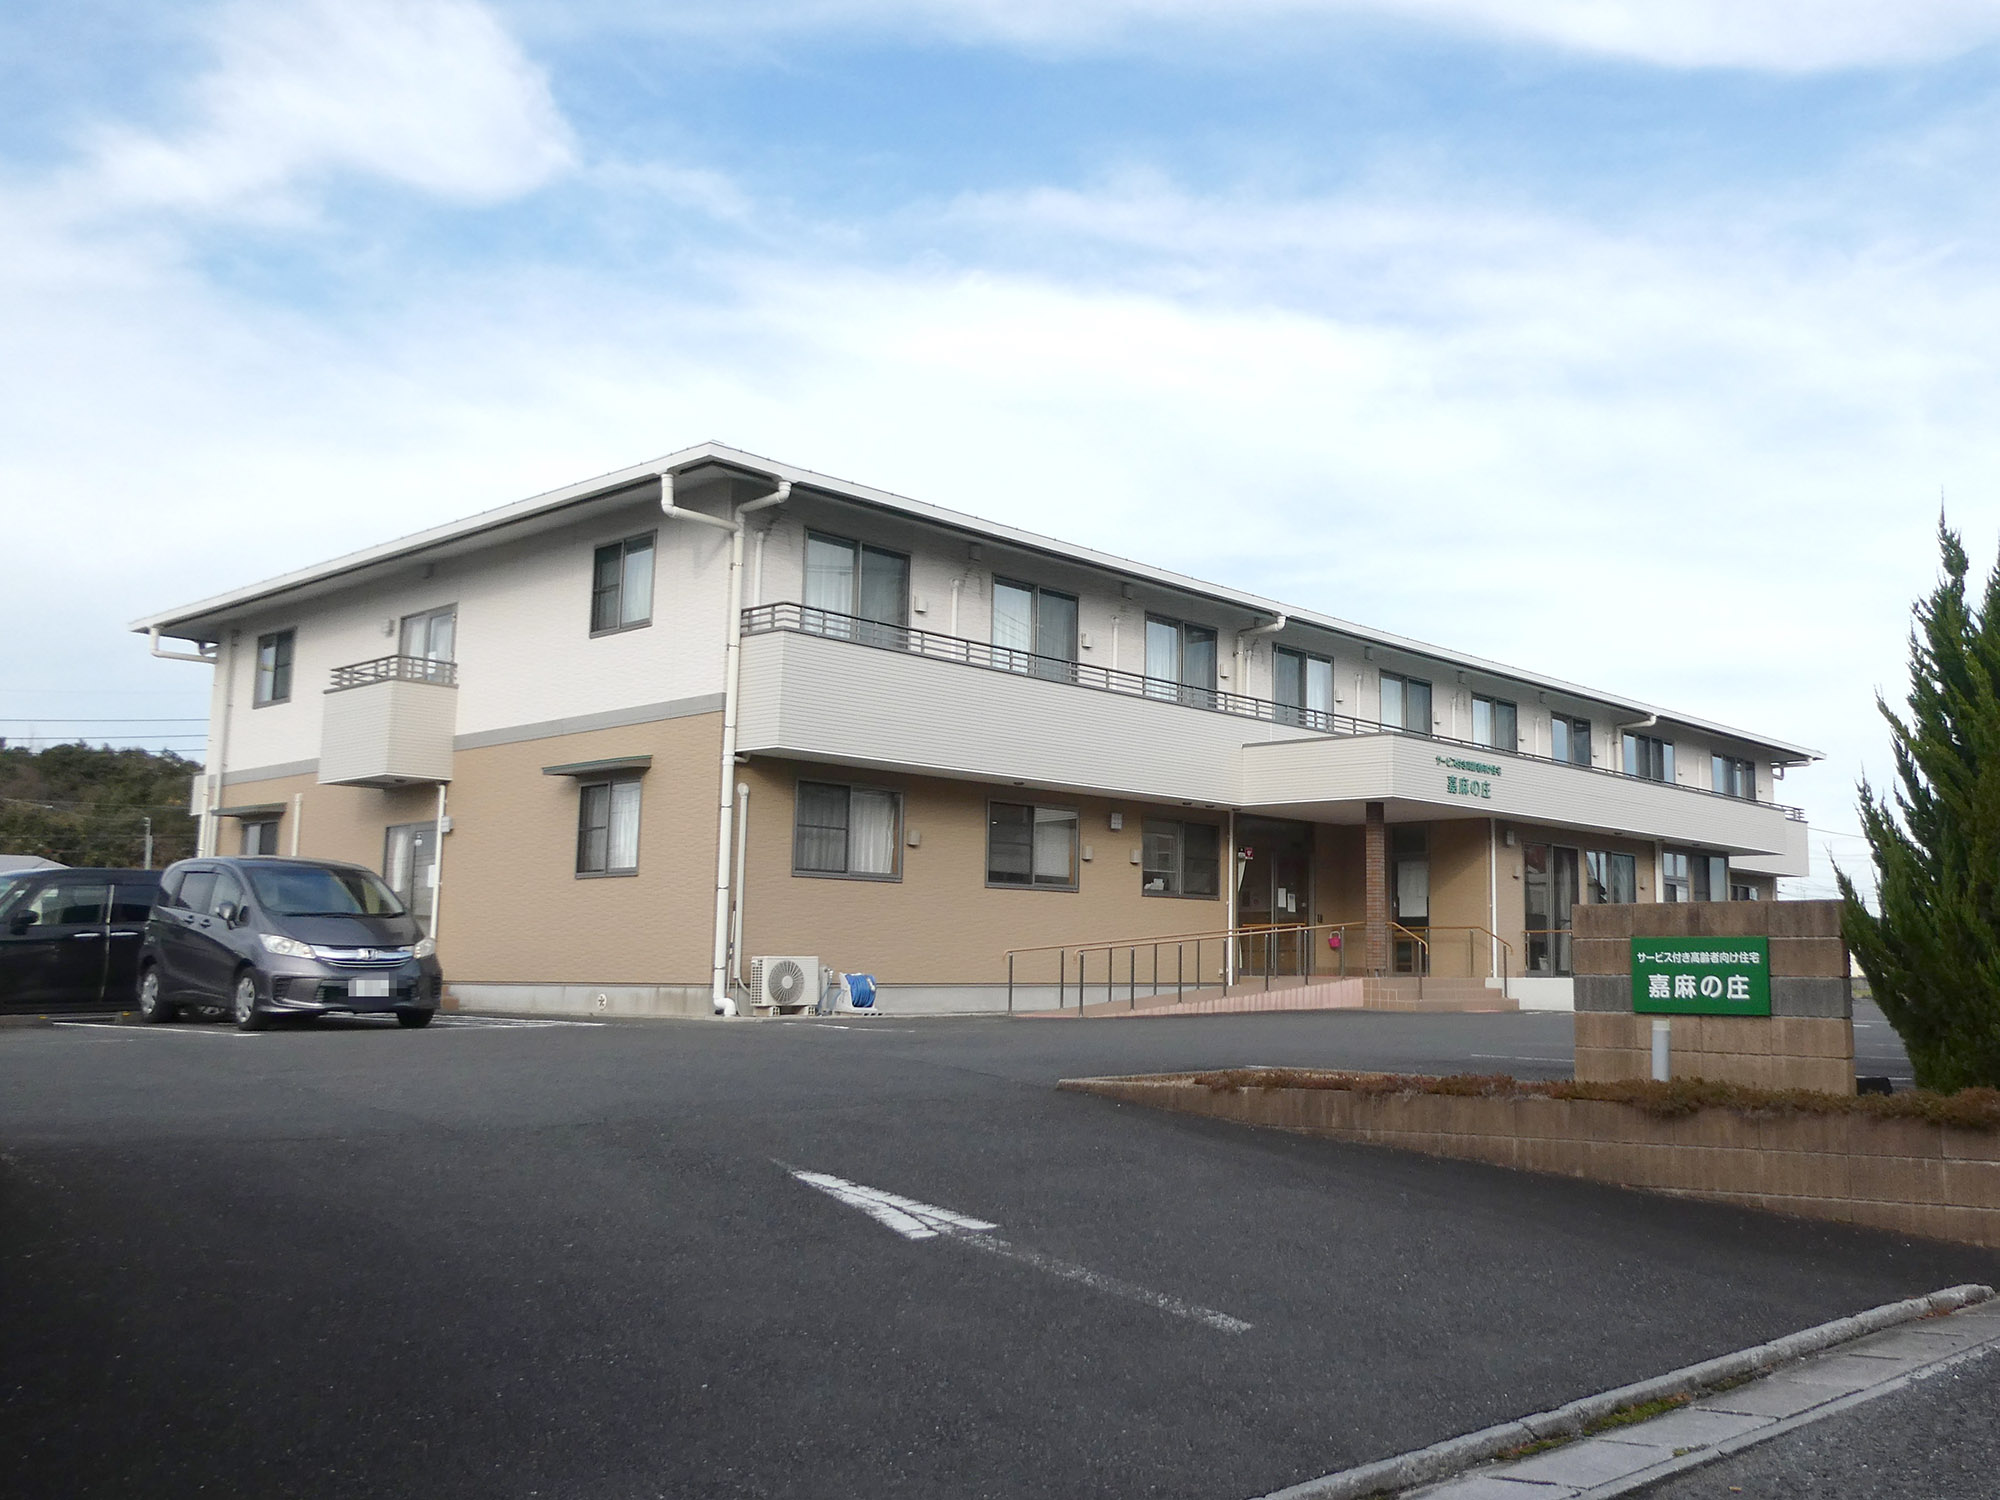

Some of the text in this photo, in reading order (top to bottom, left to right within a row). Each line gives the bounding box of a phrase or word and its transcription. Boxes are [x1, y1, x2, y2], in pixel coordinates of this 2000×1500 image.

[1447, 775, 1491, 799] 嘉麻の庄
[1637, 952, 1760, 964] サービス付き高齢者向け住宅
[1648, 973, 1751, 999] 嘉麻の庄
